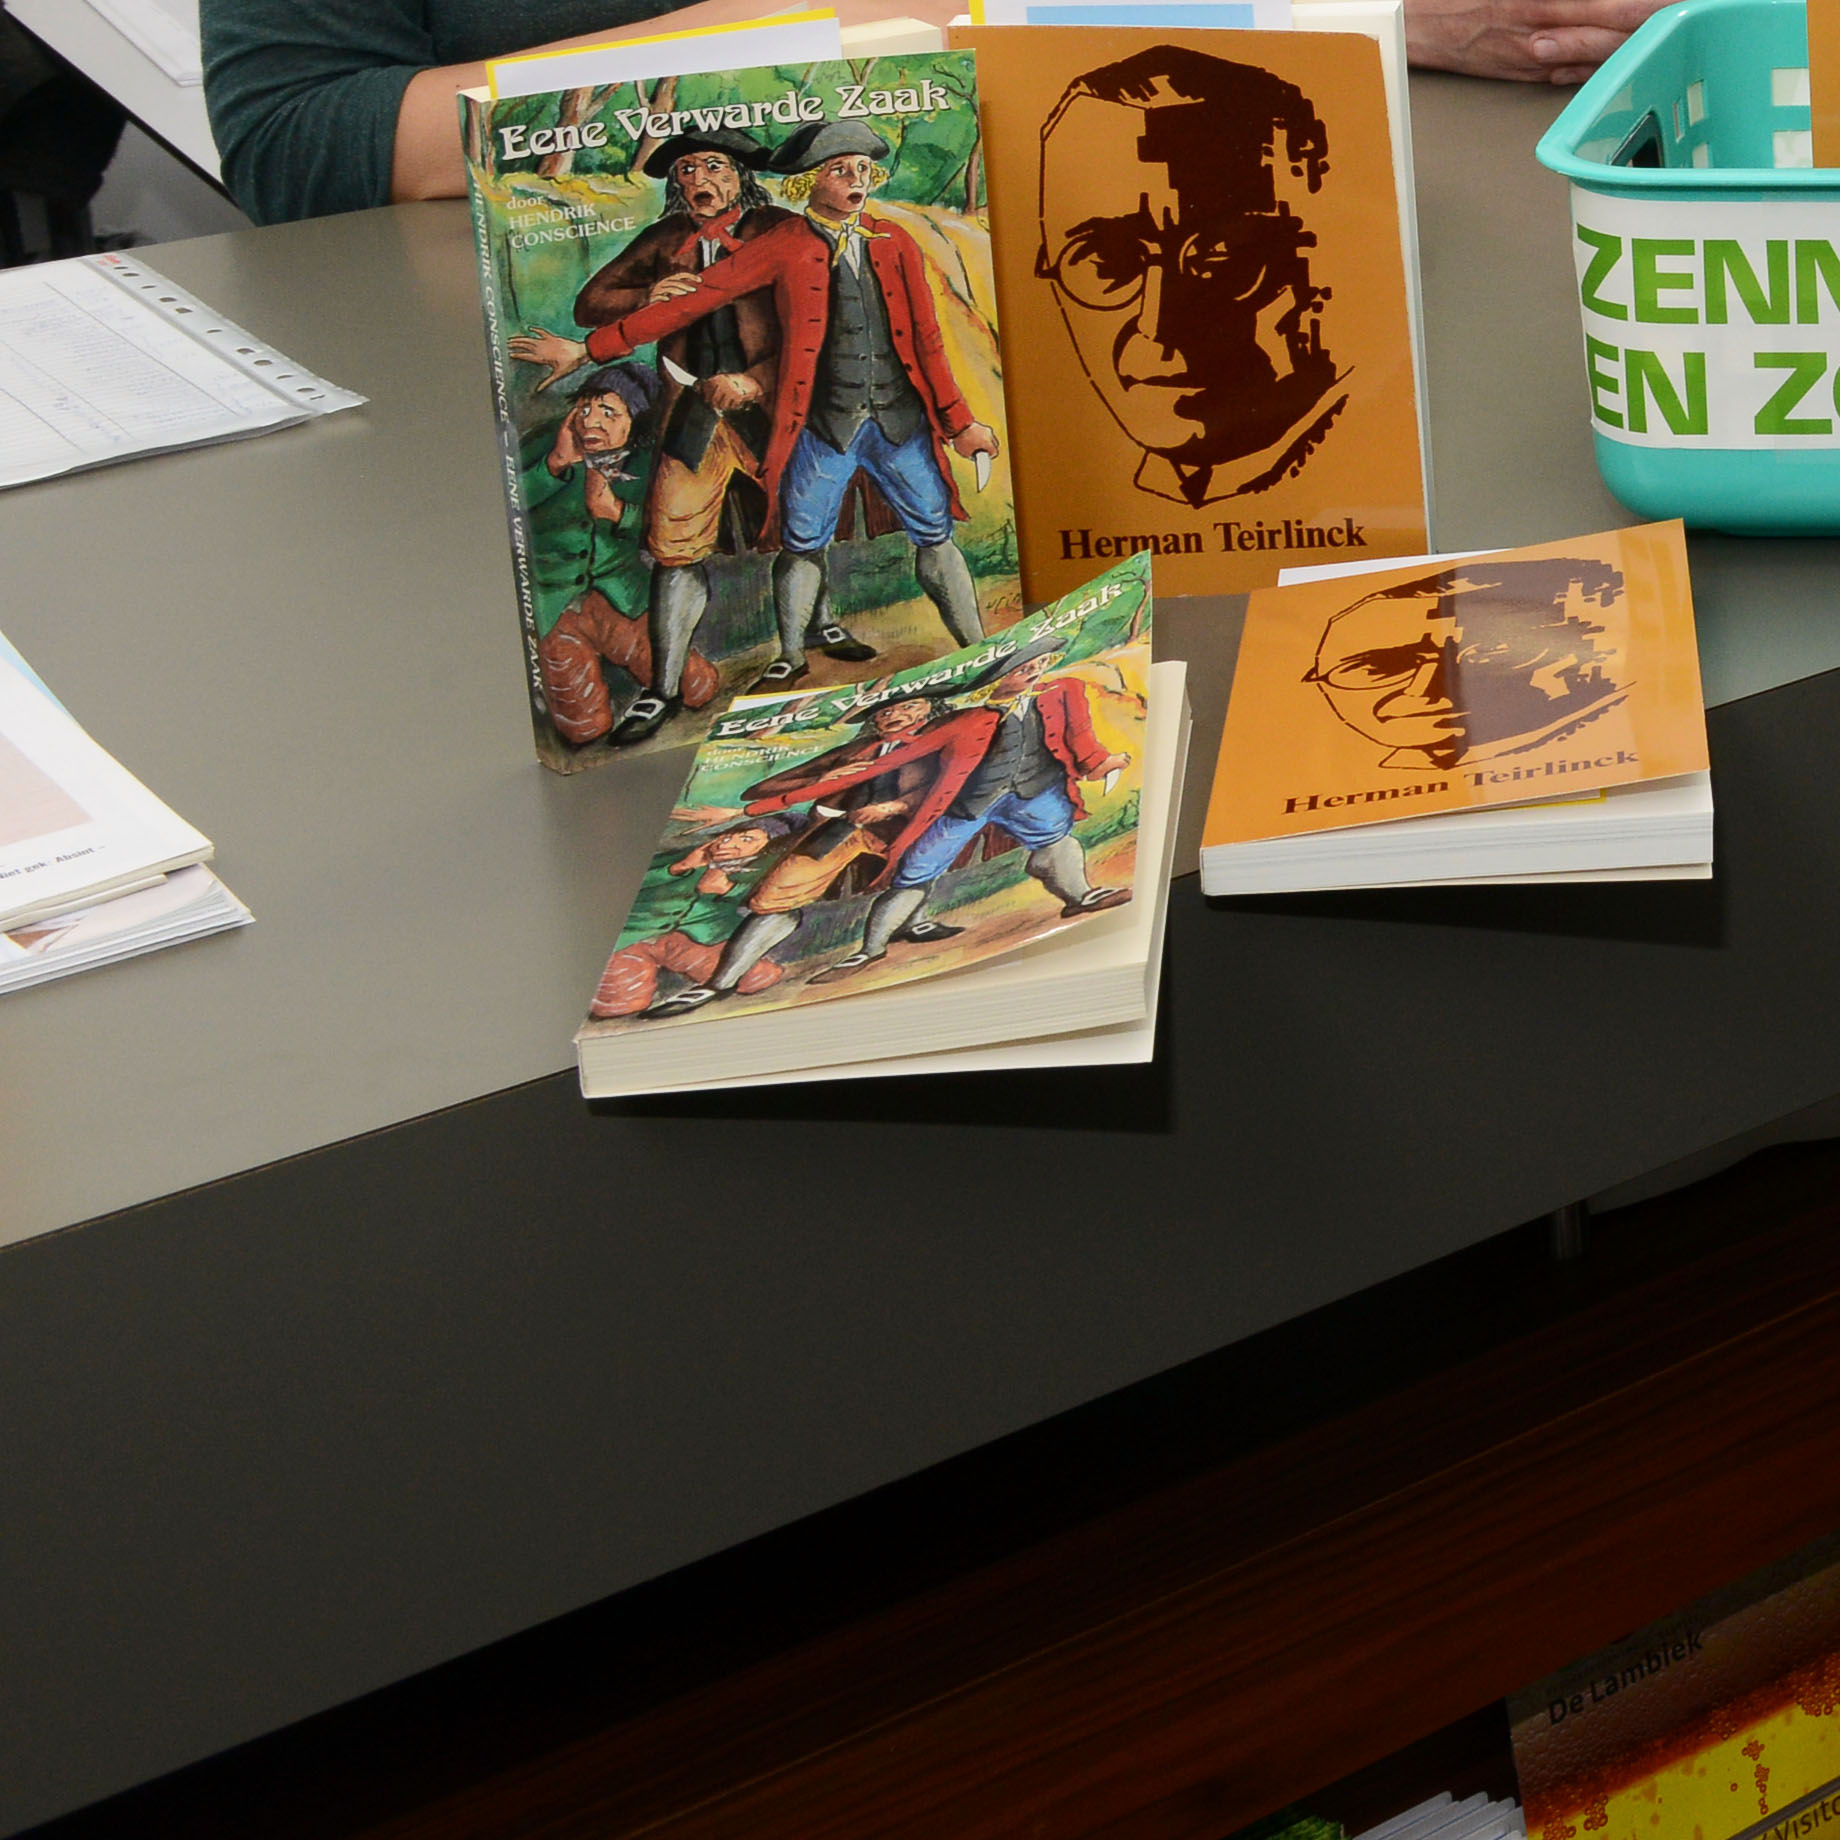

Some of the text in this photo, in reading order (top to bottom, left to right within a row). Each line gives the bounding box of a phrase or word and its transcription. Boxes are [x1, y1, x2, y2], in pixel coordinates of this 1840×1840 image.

[500, 79, 952, 162] Eene Verwarde Zaak
[506, 195, 544, 210] door
[509, 203, 596, 230] HENDRIK
[510, 217, 636, 250] CONSCIENCE
[1586, 330, 1710, 436] EN
[474, 182, 543, 688] HENDRIK CONSCIENCE EENE VERWARDE ZAAK
[1059, 518, 1368, 560] Herman Teirlinck
[717, 581, 1126, 737] Eene Verwarde Zaak
[700, 745, 824, 772] CONSCIENCE
[1281, 749, 1641, 816] Herman Teirlinck
[1549, 1629, 1704, 1725] De Lambiek
